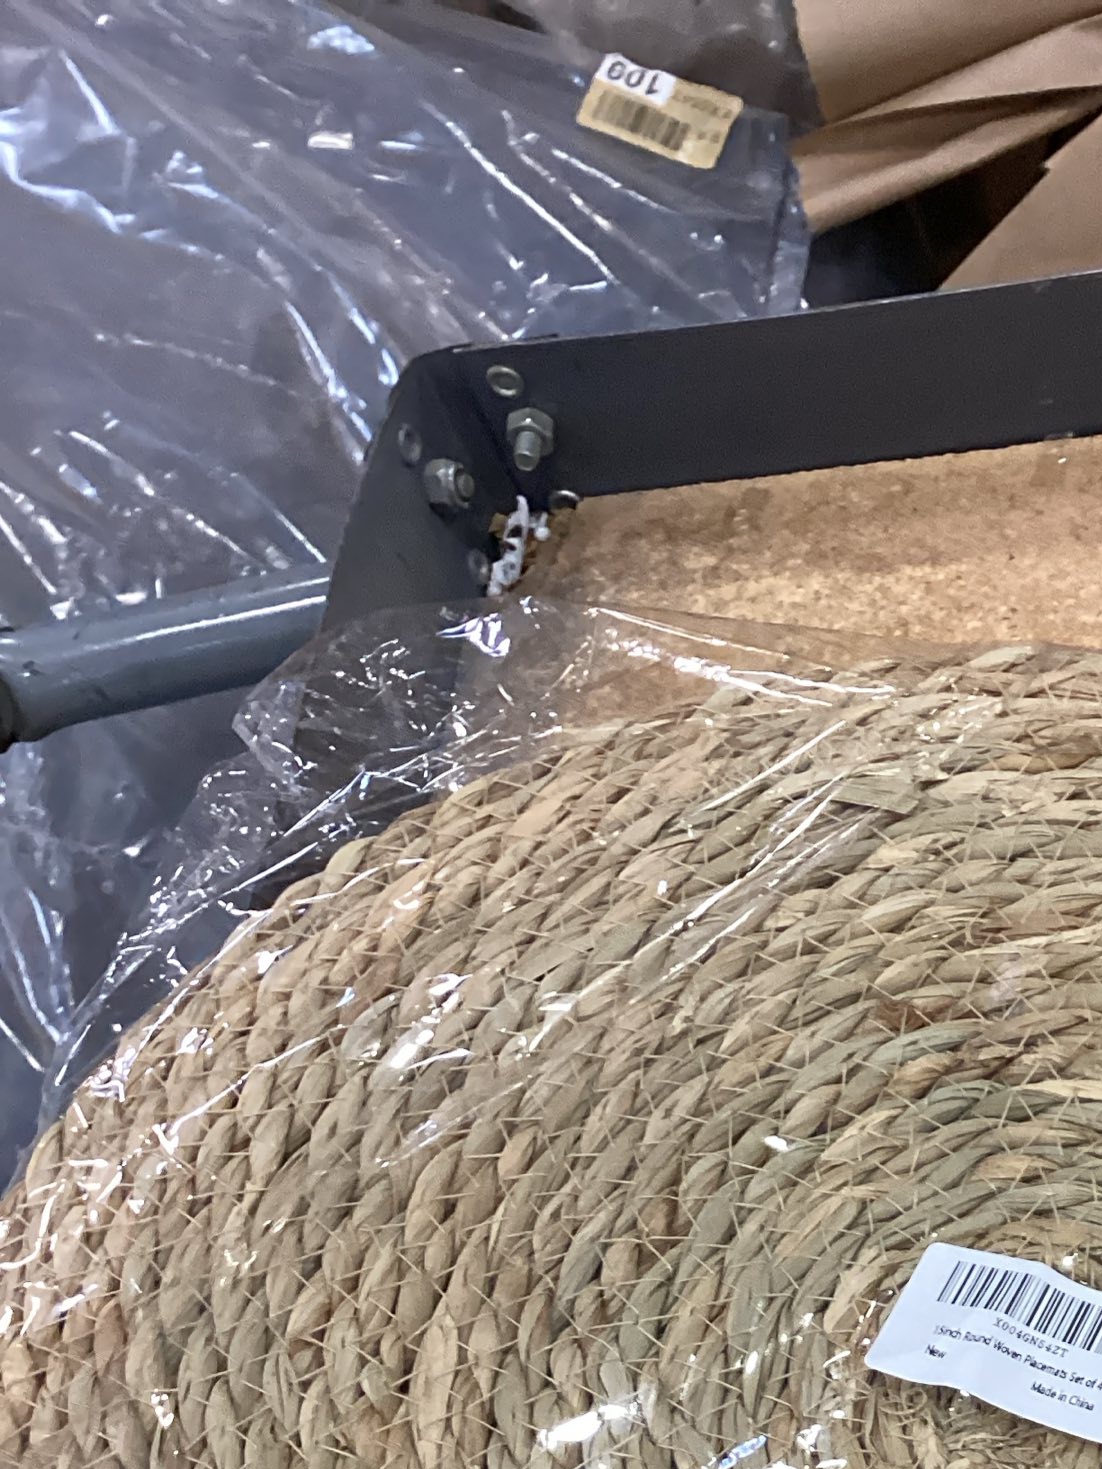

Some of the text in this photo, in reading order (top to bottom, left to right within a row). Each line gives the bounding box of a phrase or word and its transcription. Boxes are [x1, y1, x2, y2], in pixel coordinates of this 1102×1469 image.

[924, 1343, 946, 1359] New
[962, 1329, 994, 1346] Round
[994, 1338, 1022, 1361] Woven
[1024, 1354, 1068, 1379] Placemats
[1069, 1372, 1084, 1386] Set
[1085, 1376, 1097, 1388] of
[1030, 1380, 1095, 1411] Made in China
